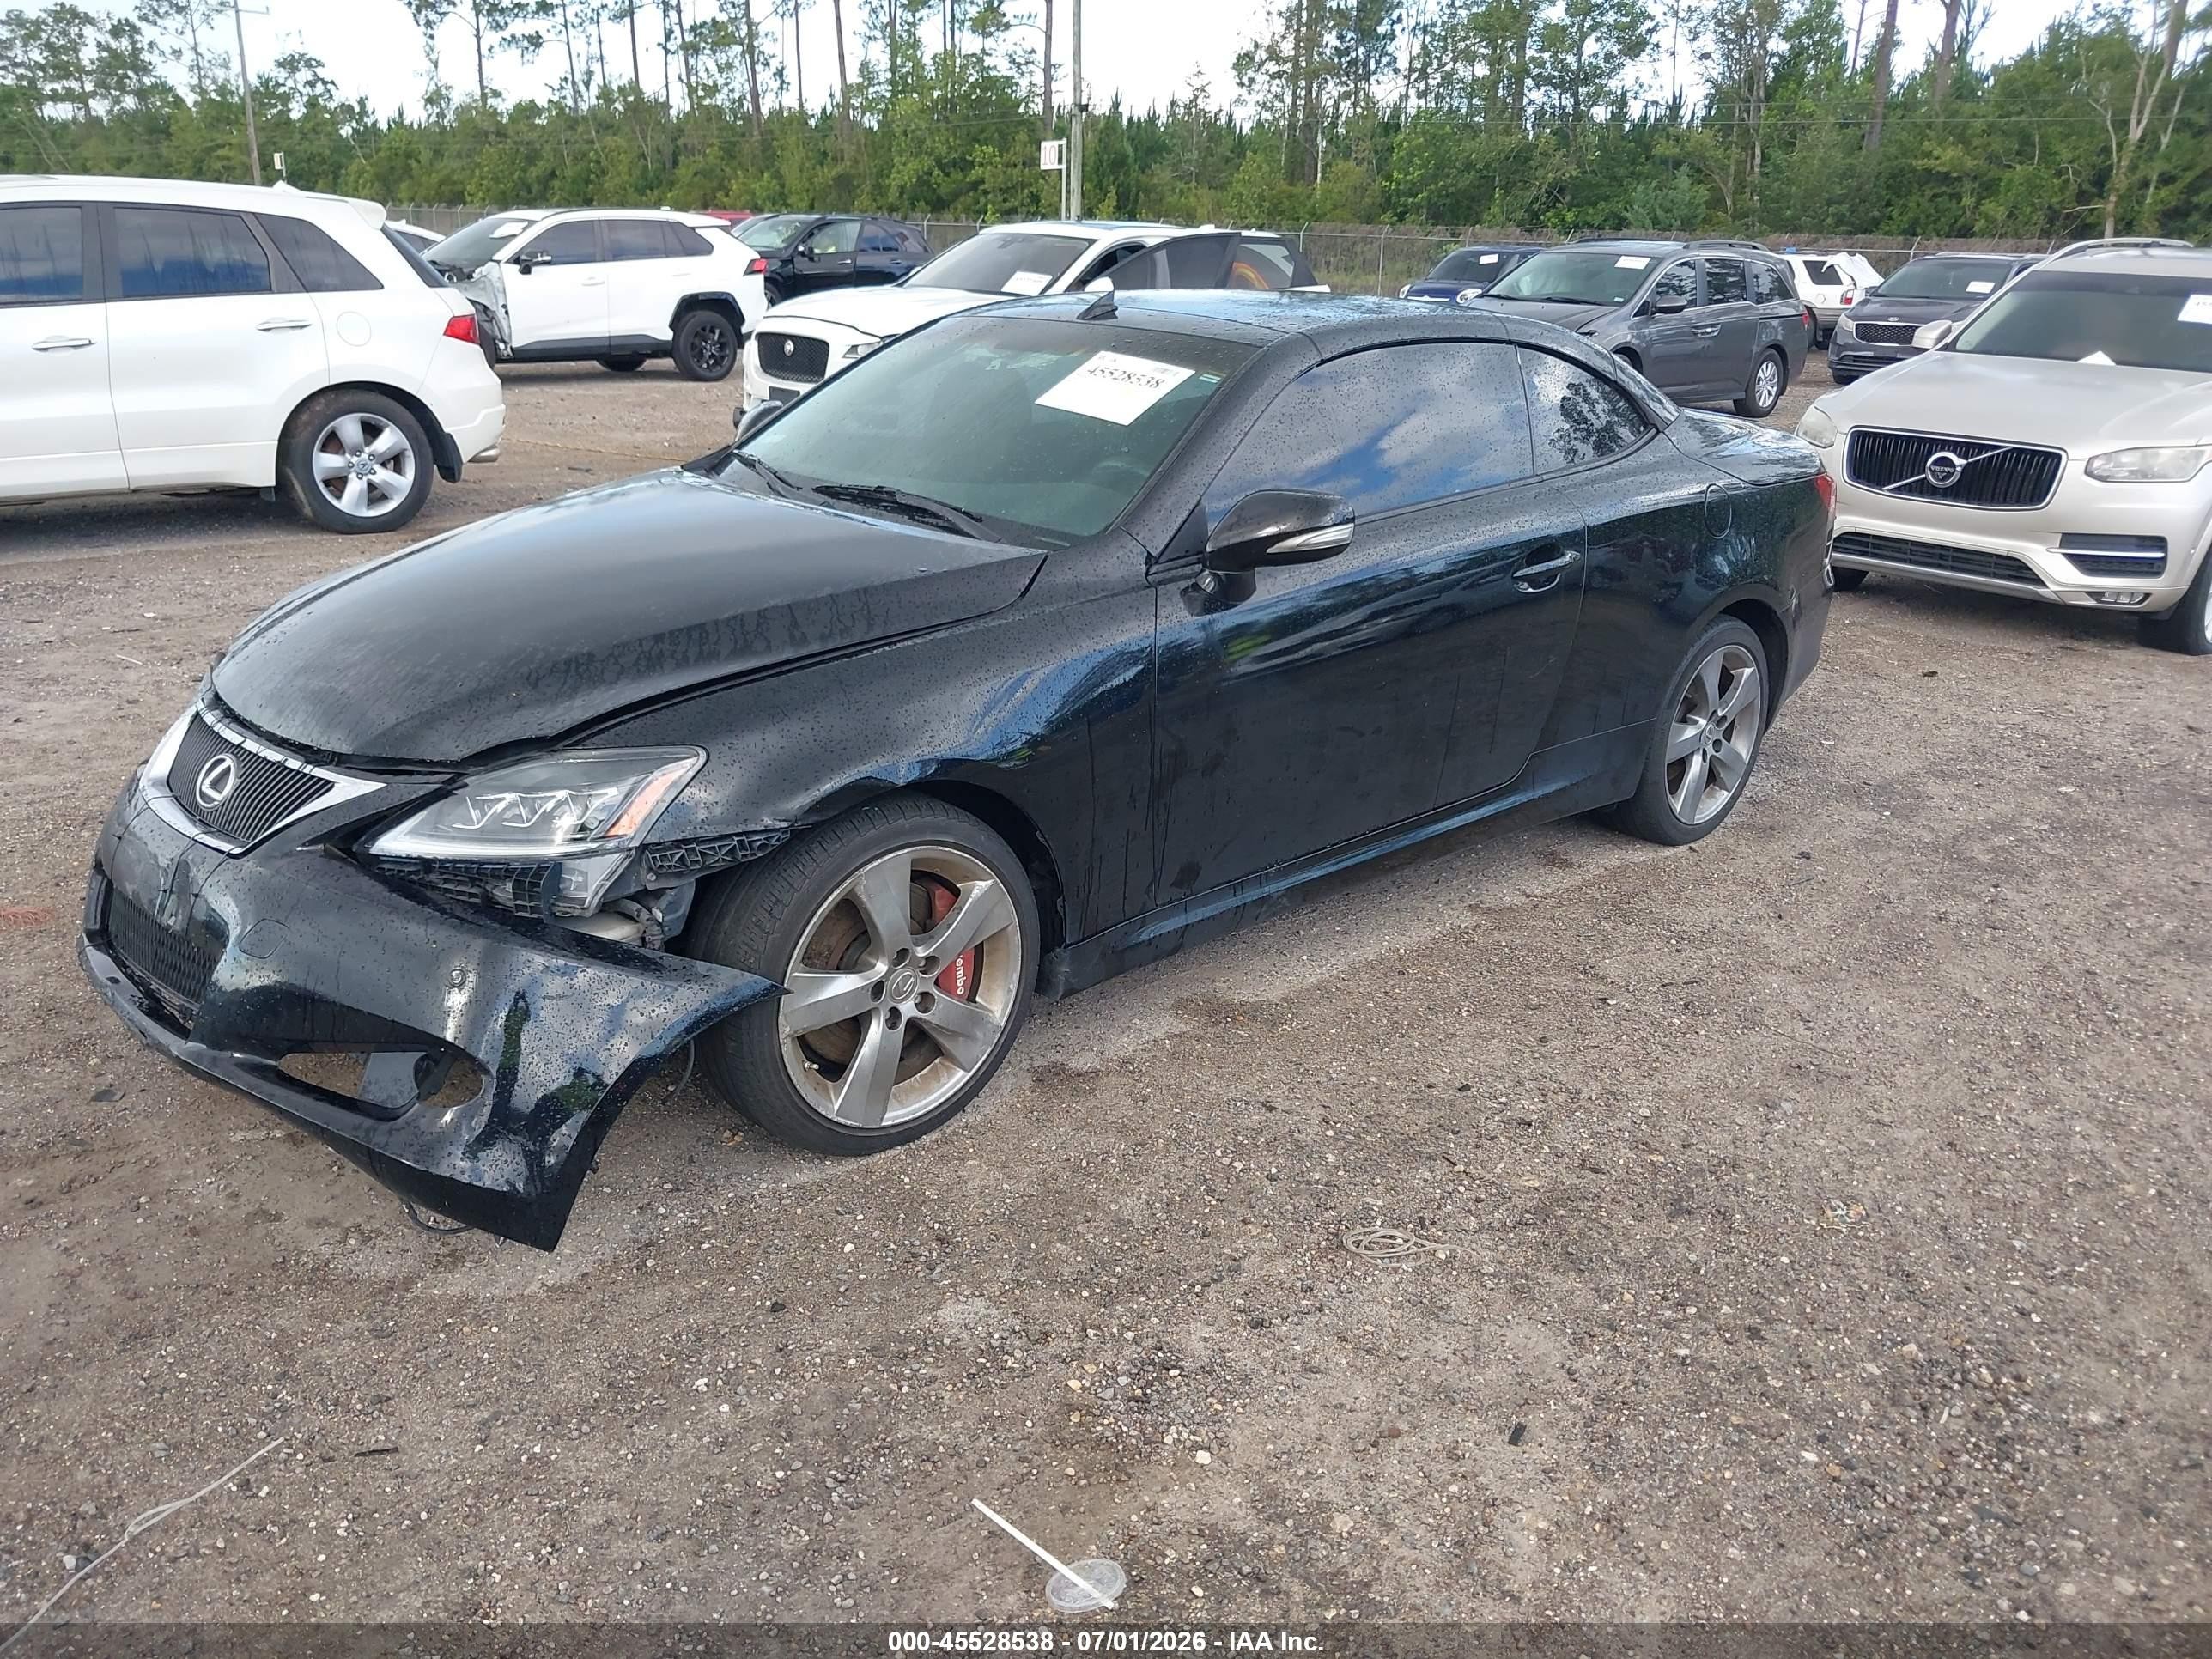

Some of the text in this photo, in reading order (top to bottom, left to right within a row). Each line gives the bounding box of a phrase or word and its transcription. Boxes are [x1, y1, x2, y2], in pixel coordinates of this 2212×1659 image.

[1042, 144, 1057, 166] 10
[1087, 366, 1166, 389] 45528538
[1930, 465, 1954, 473] VOLVO
[955, 954, 967, 995] embo
